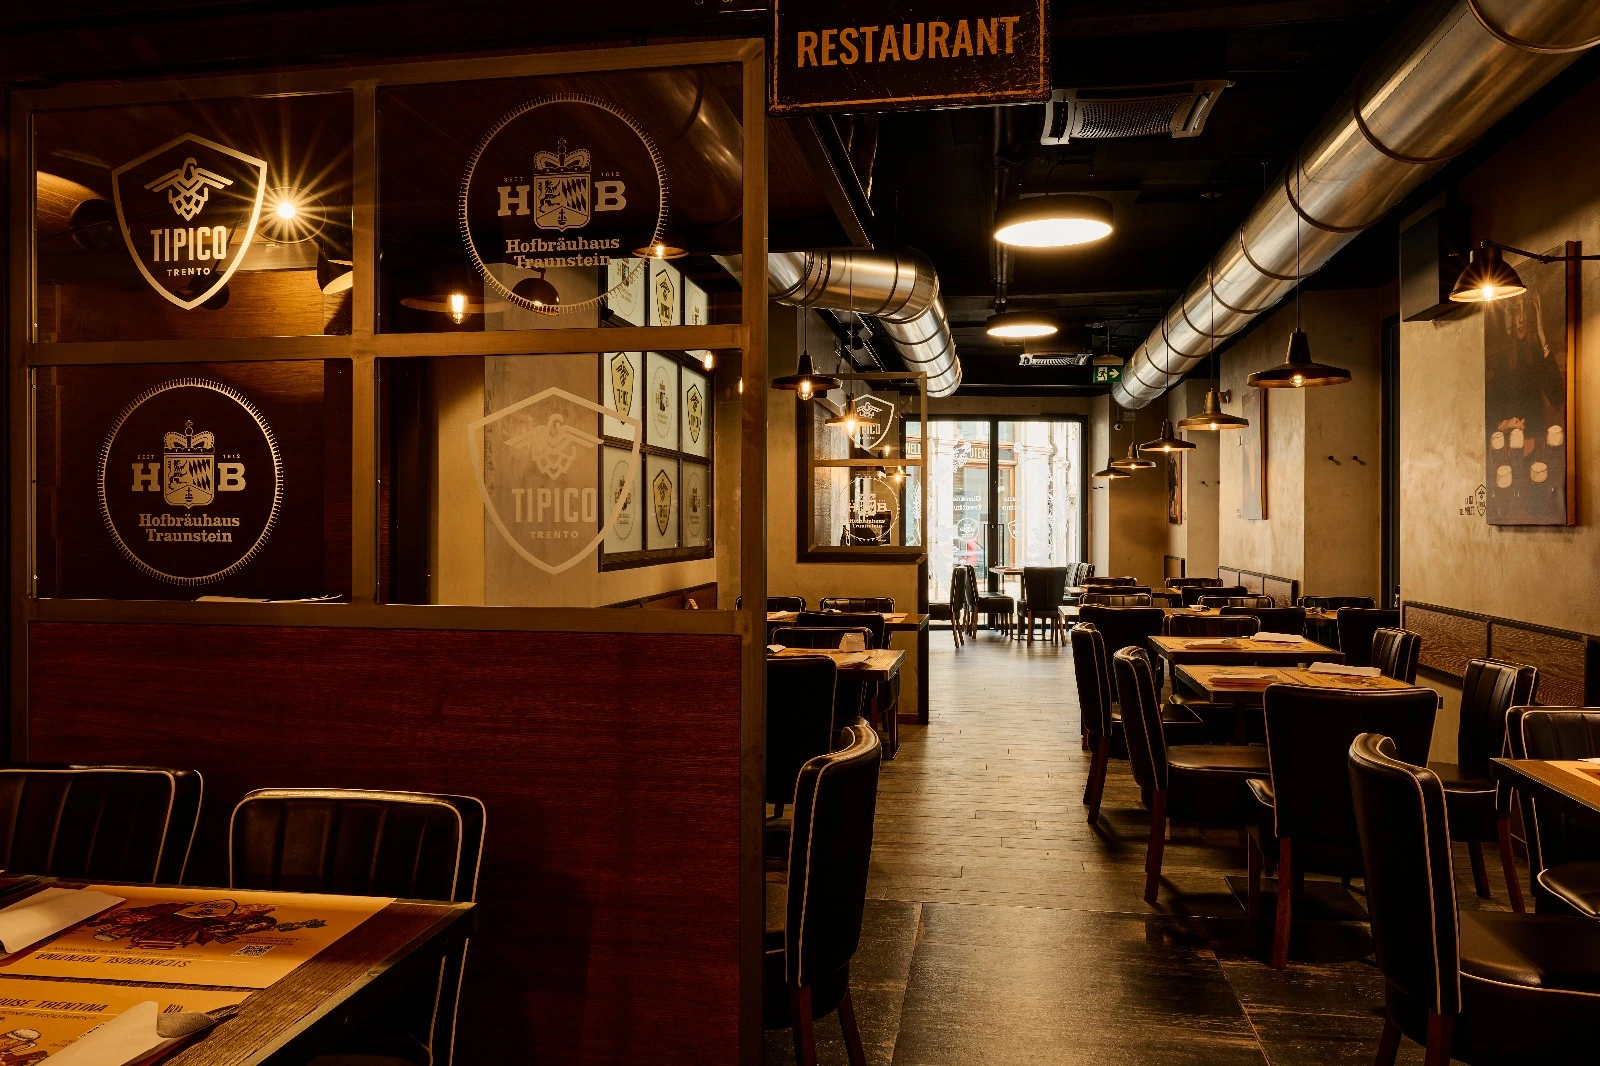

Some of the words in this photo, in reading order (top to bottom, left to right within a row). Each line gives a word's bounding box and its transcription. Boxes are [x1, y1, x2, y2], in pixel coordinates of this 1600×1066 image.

[797, 16, 1020, 68] RESTAURANT
[497, 184, 531, 217] H
[594, 180, 627, 212] B
[150, 225, 227, 262] TIPICO
[505, 236, 620, 254] Hofbräuhaus
[513, 252, 612, 269] Traunstein
[166, 266, 211, 277] TRENTO
[131, 462, 161, 492] H
[217, 462, 247, 492] B
[511, 487, 597, 523] TIPICO
[138, 513, 241, 527] Hofbräuhaus
[145, 528, 233, 543] Traunstein
[529, 530, 579, 539] TRENTO
[103, 956, 192, 968] STEAKHOUSE
[35, 1000, 110, 1012] TRENTINA
